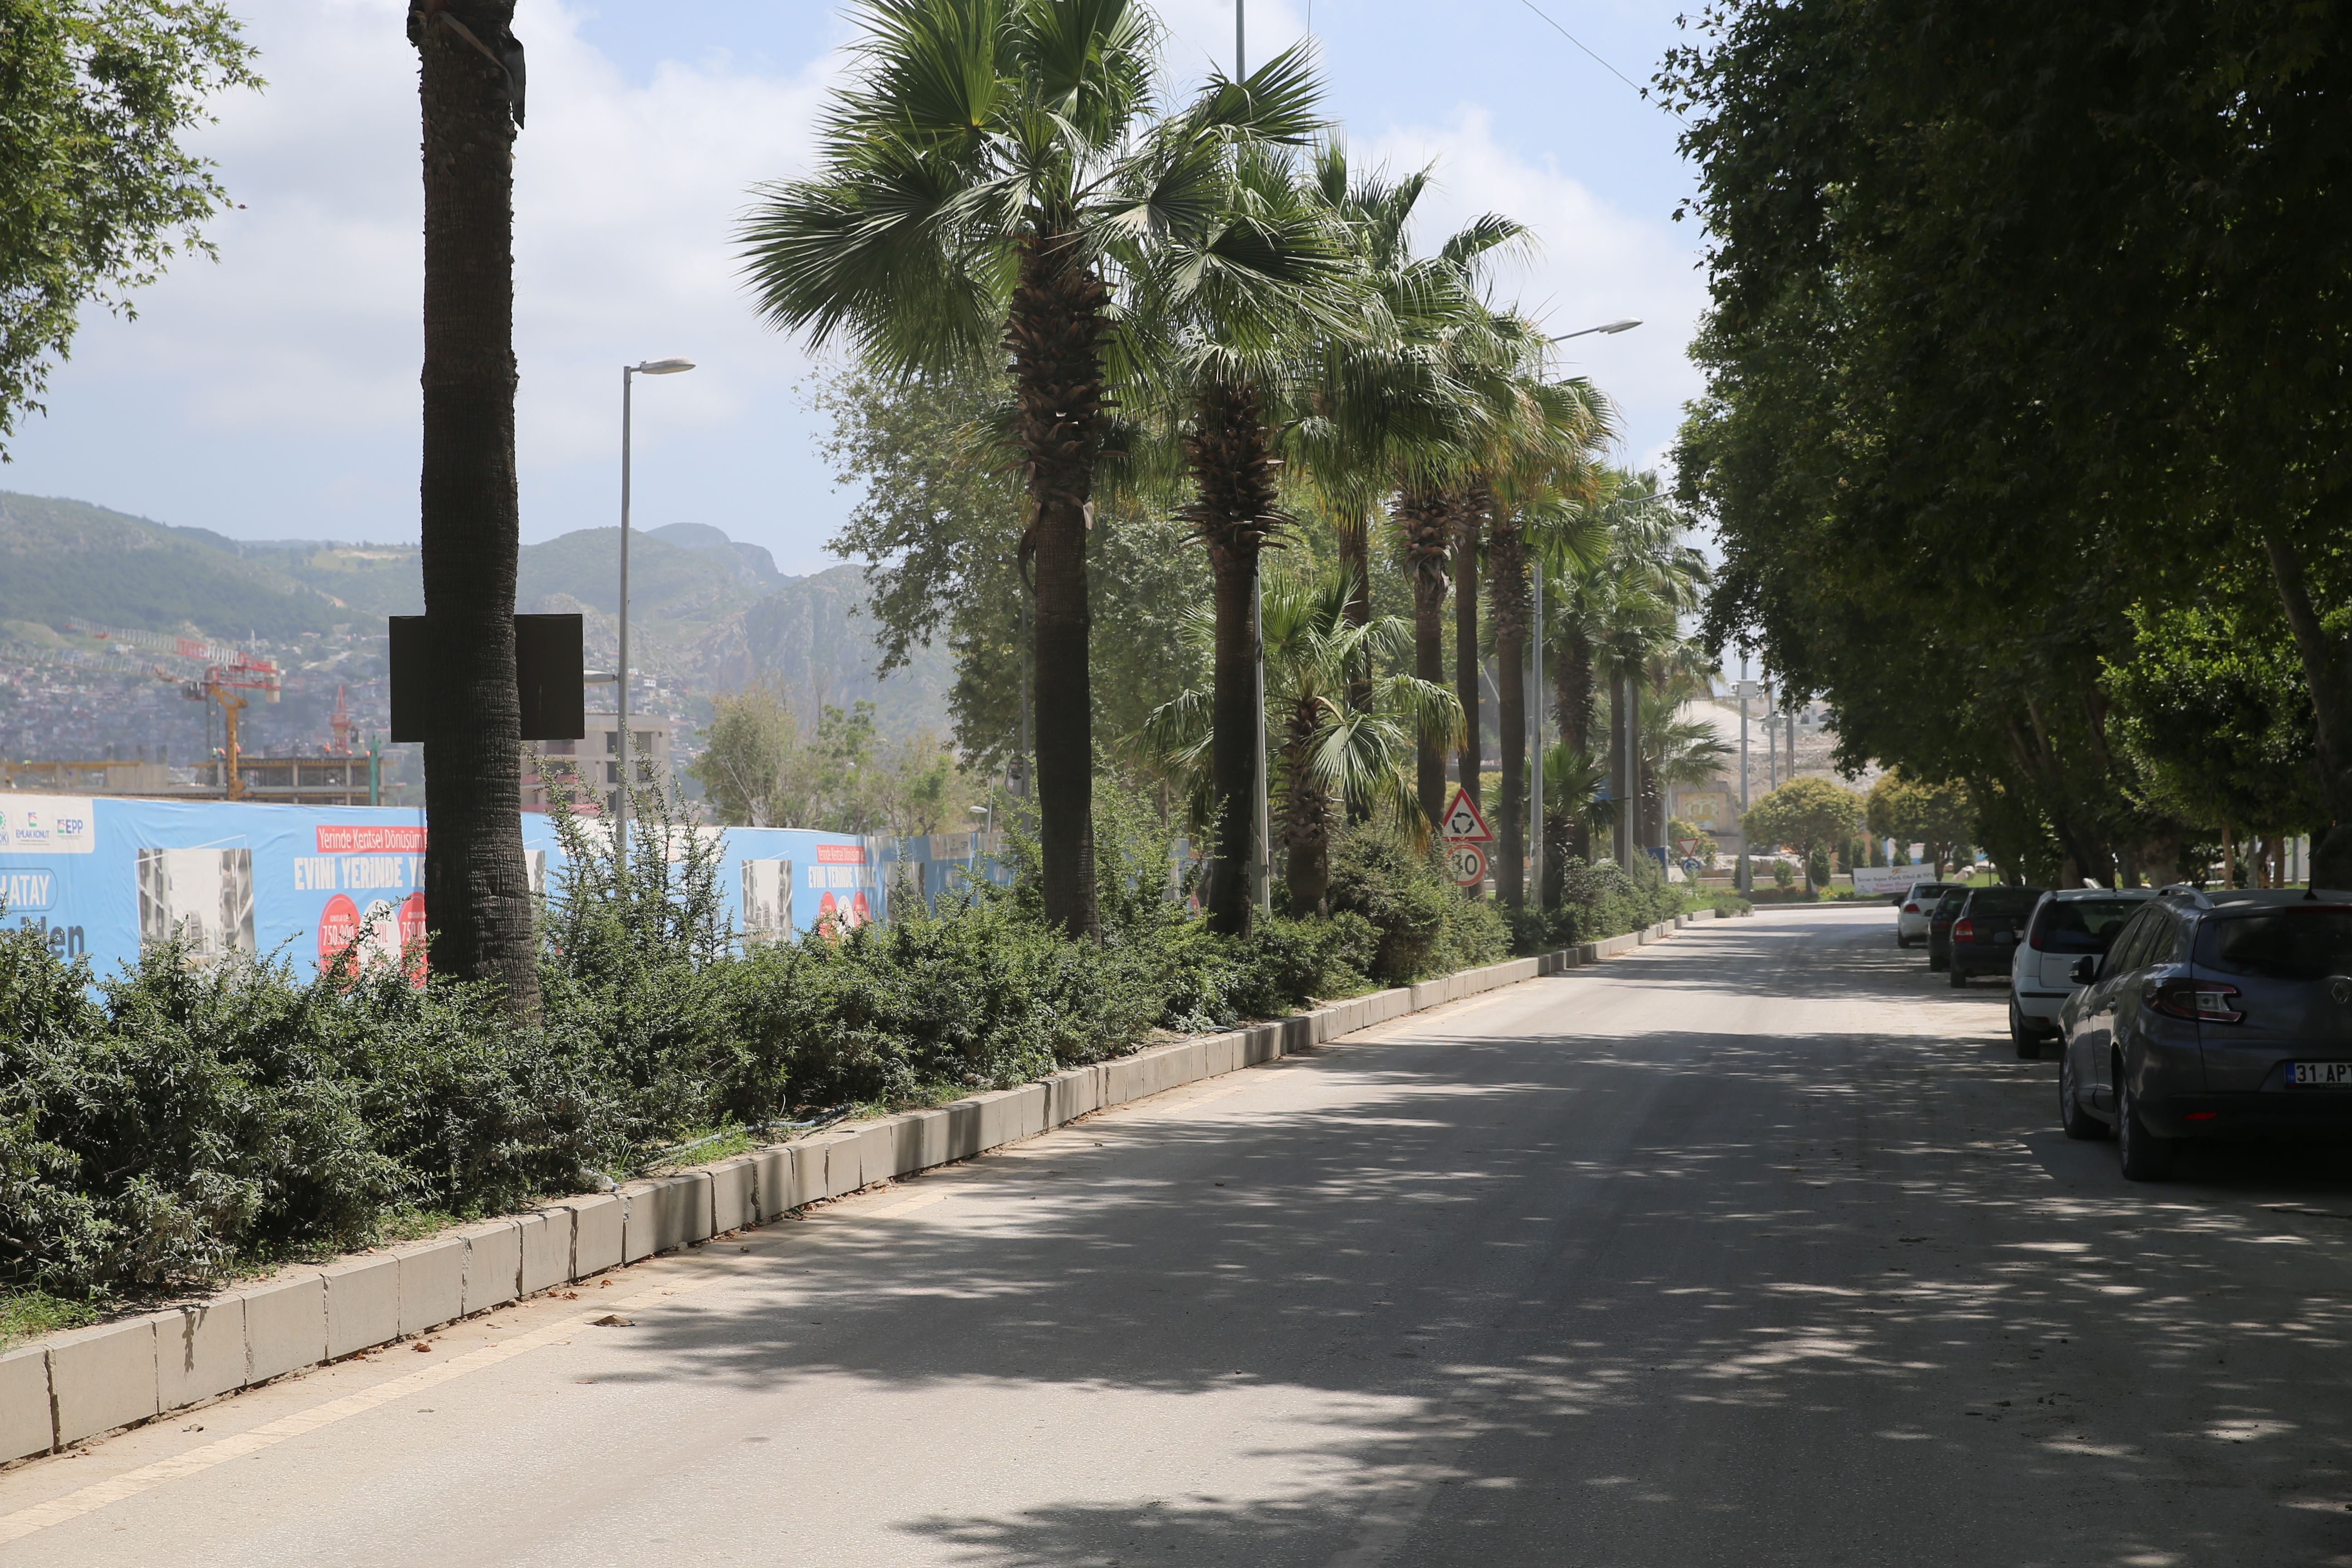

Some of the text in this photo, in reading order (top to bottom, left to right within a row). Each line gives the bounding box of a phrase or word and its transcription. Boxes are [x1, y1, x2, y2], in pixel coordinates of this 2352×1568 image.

[33, 830, 50, 838] KONUT
[65, 819, 83, 834] EPP
[318, 828, 352, 849] Yerinde
[353, 828, 383, 849] Kentsel
[385, 828, 423, 851] Dönüşüm
[294, 857, 336, 891] EVİNİ
[341, 857, 403, 889] YERİNDE
[2296, 1064, 2317, 1083] 31
